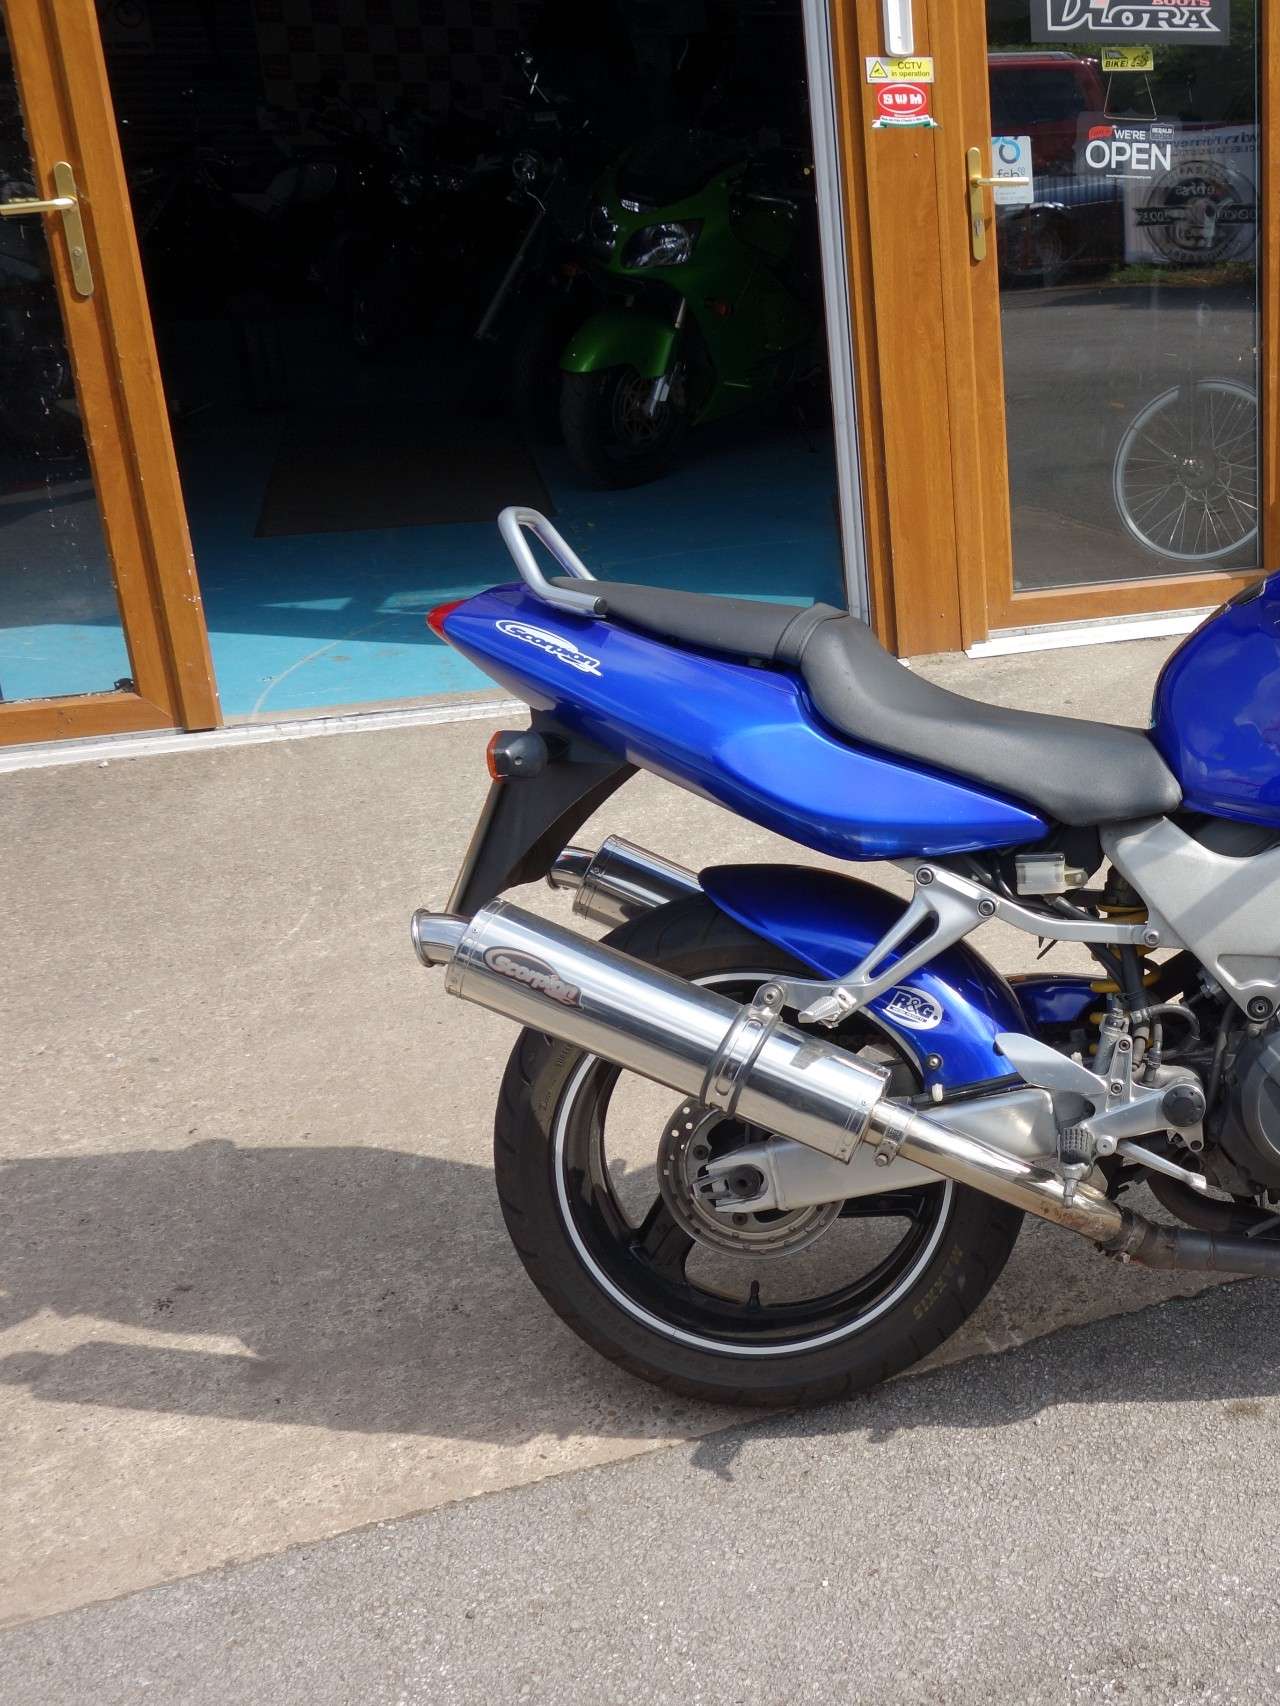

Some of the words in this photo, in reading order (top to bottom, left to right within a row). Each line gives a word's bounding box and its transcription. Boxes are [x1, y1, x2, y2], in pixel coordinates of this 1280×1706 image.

[897, 61, 922, 69] CCTV
[900, 71, 930, 79] operation
[1114, 129, 1147, 140] WE'RE
[1085, 140, 1172, 171] OPEN
[493, 953, 580, 1002] Scorpion
